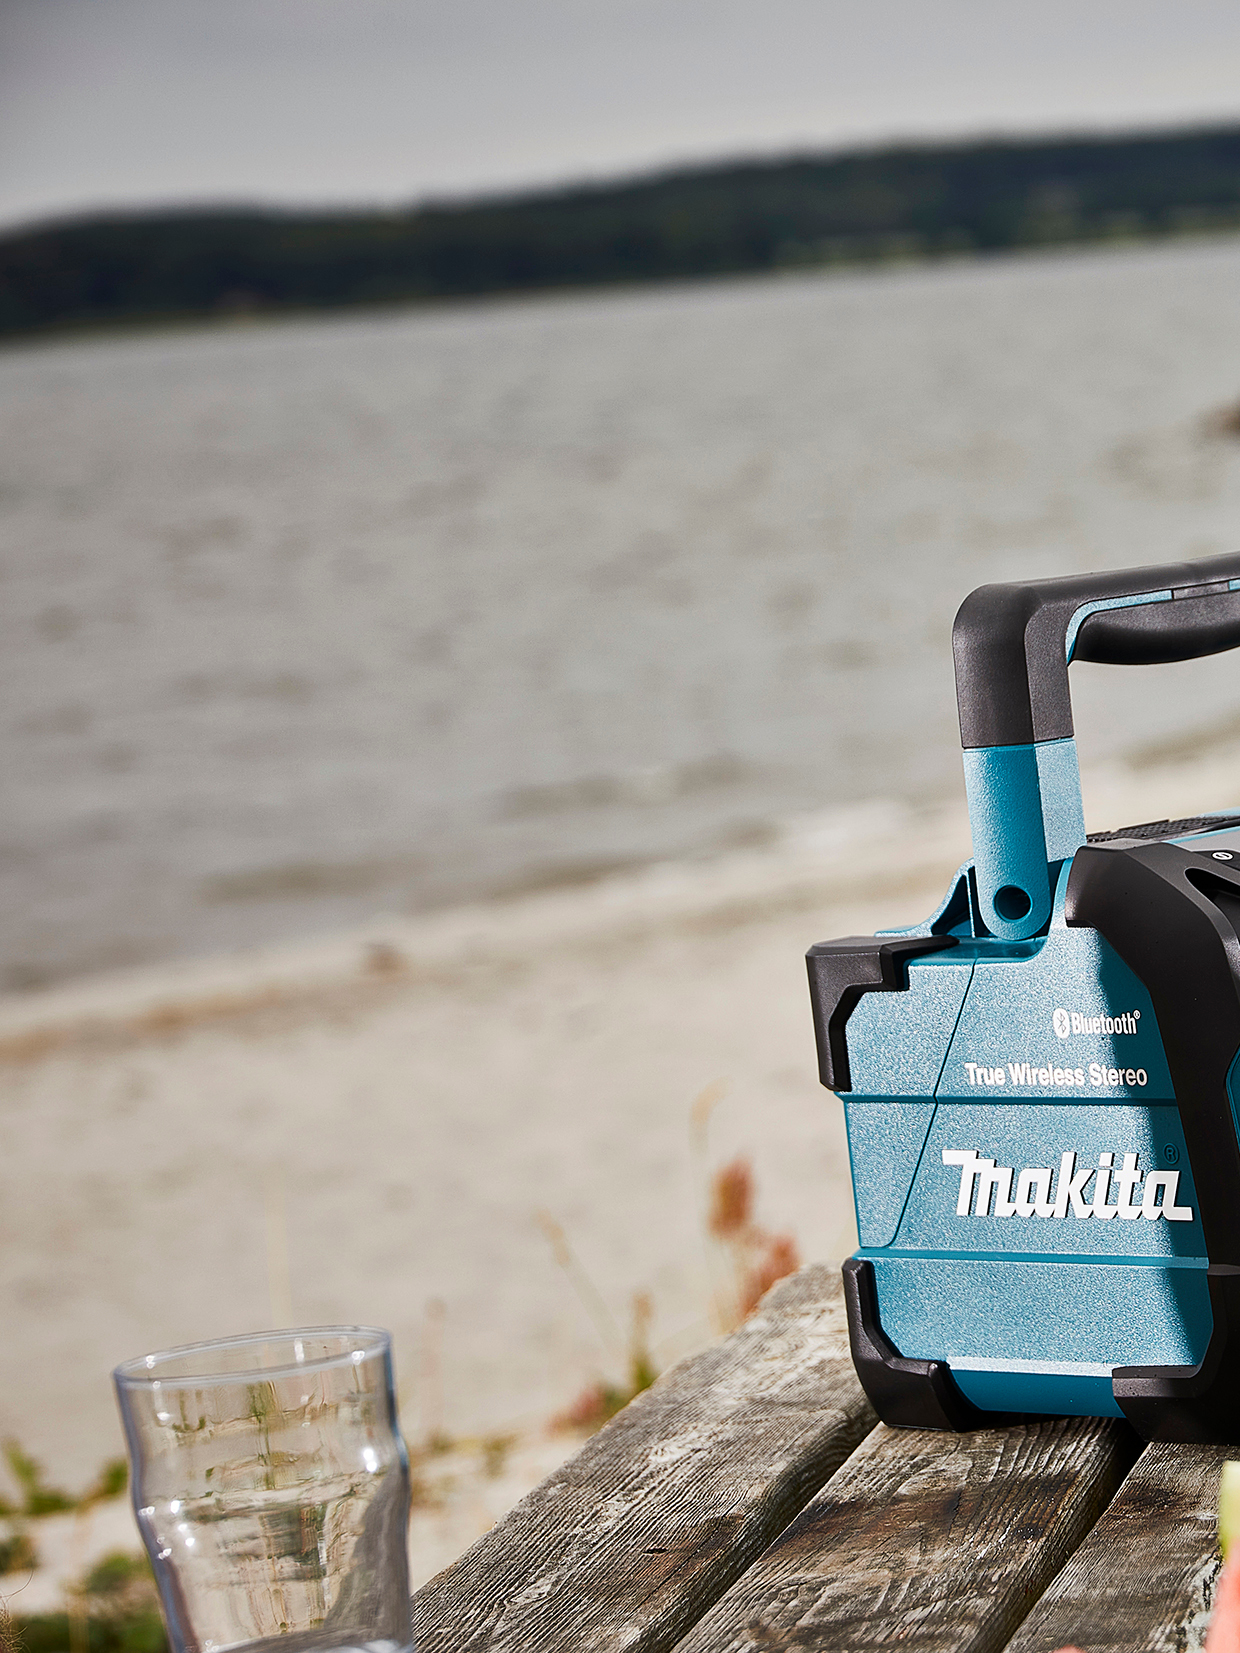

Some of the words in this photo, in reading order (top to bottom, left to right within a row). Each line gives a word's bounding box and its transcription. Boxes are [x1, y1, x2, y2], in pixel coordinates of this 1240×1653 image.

[965, 1062, 1005, 1086] True
[1007, 1062, 1085, 1086] Wireless
[1088, 1063, 1148, 1086] Stereo
